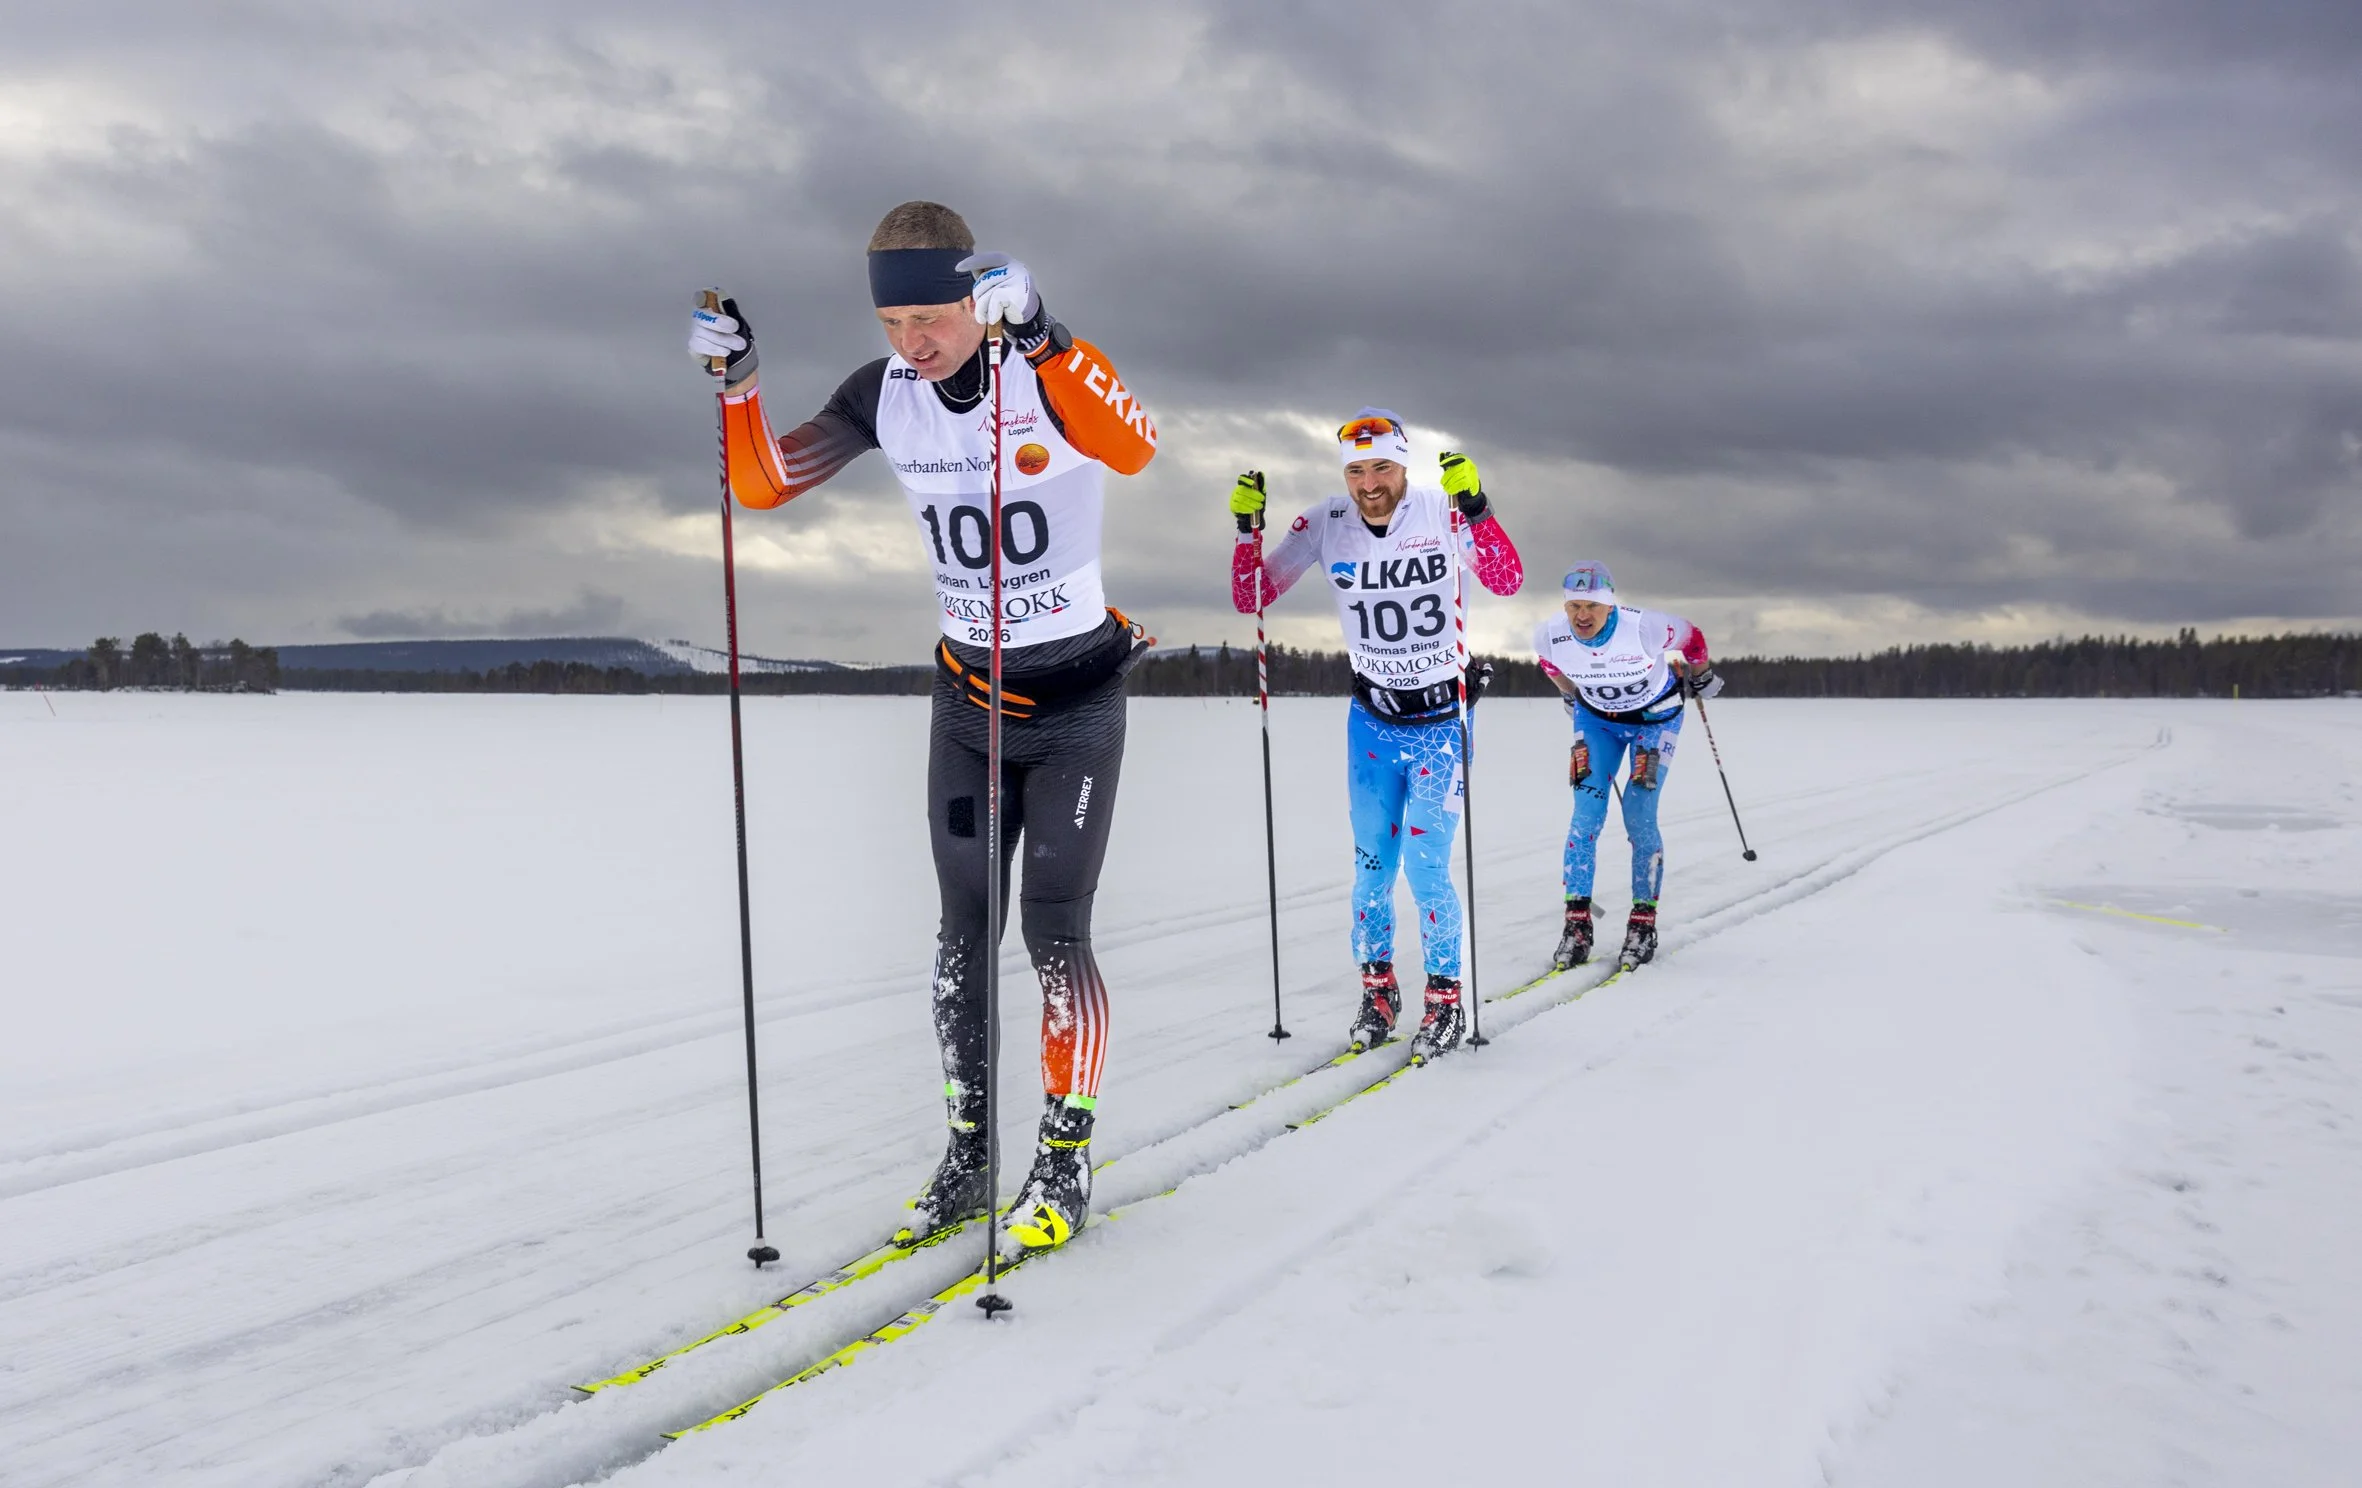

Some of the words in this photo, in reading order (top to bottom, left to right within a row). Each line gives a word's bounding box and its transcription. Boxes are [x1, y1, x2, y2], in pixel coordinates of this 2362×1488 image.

[890, 368, 922, 381] BO
[1008, 426, 1034, 436] Loppet
[893, 457, 962, 474] parbanken
[966, 457, 996, 472] Nor
[921, 501, 1049, 570] 100
[978, 569, 1051, 590] Lvgren
[1361, 554, 1447, 590] LKAB
[1348, 593, 1446, 642] 103
[968, 627, 1011, 643] 206
[1552, 635, 1572, 645] BOX
[1360, 643, 1407, 655] Thomas
[1411, 640, 1440, 652] Bing
[1355, 646, 1456, 673] JOKKMOKK
[1386, 676, 1420, 687] 2026
[1075, 776, 1093, 816] TERREX
